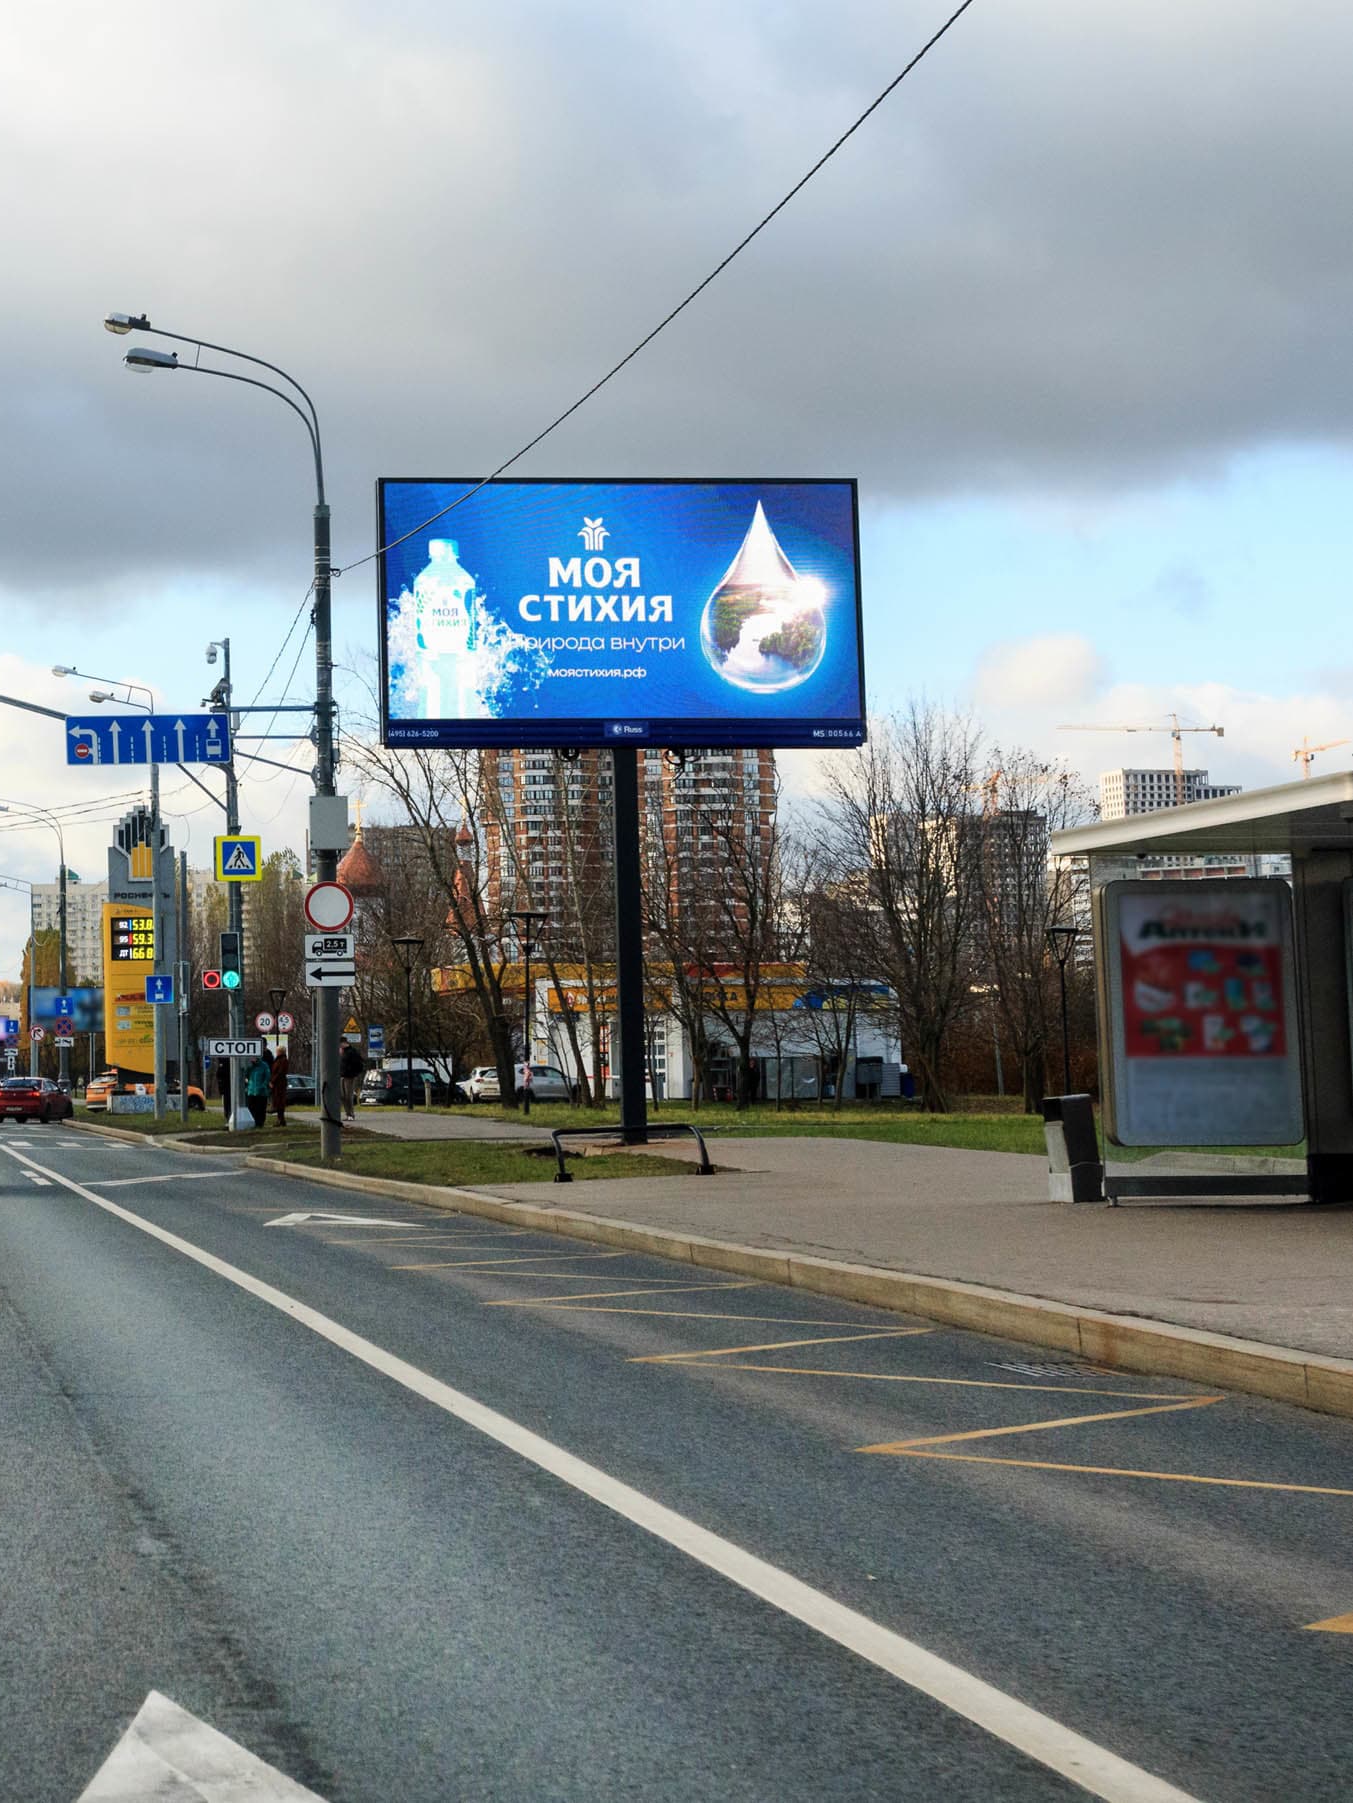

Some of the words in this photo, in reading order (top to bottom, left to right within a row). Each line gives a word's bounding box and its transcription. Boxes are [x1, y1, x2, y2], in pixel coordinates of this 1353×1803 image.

[549, 557, 640, 588] МОЯ
[432, 608, 459, 616] МОЯ
[518, 594, 673, 622] СТИХИЯ
[513, 636, 605, 652] рирода
[611, 636, 685, 652] внутри
[549, 666, 647, 679] моястихия.рф
[623, 725, 643, 733] Russ
[260, 1018, 271, 1026] 20
[215, 1042, 257, 1054] СТОП
